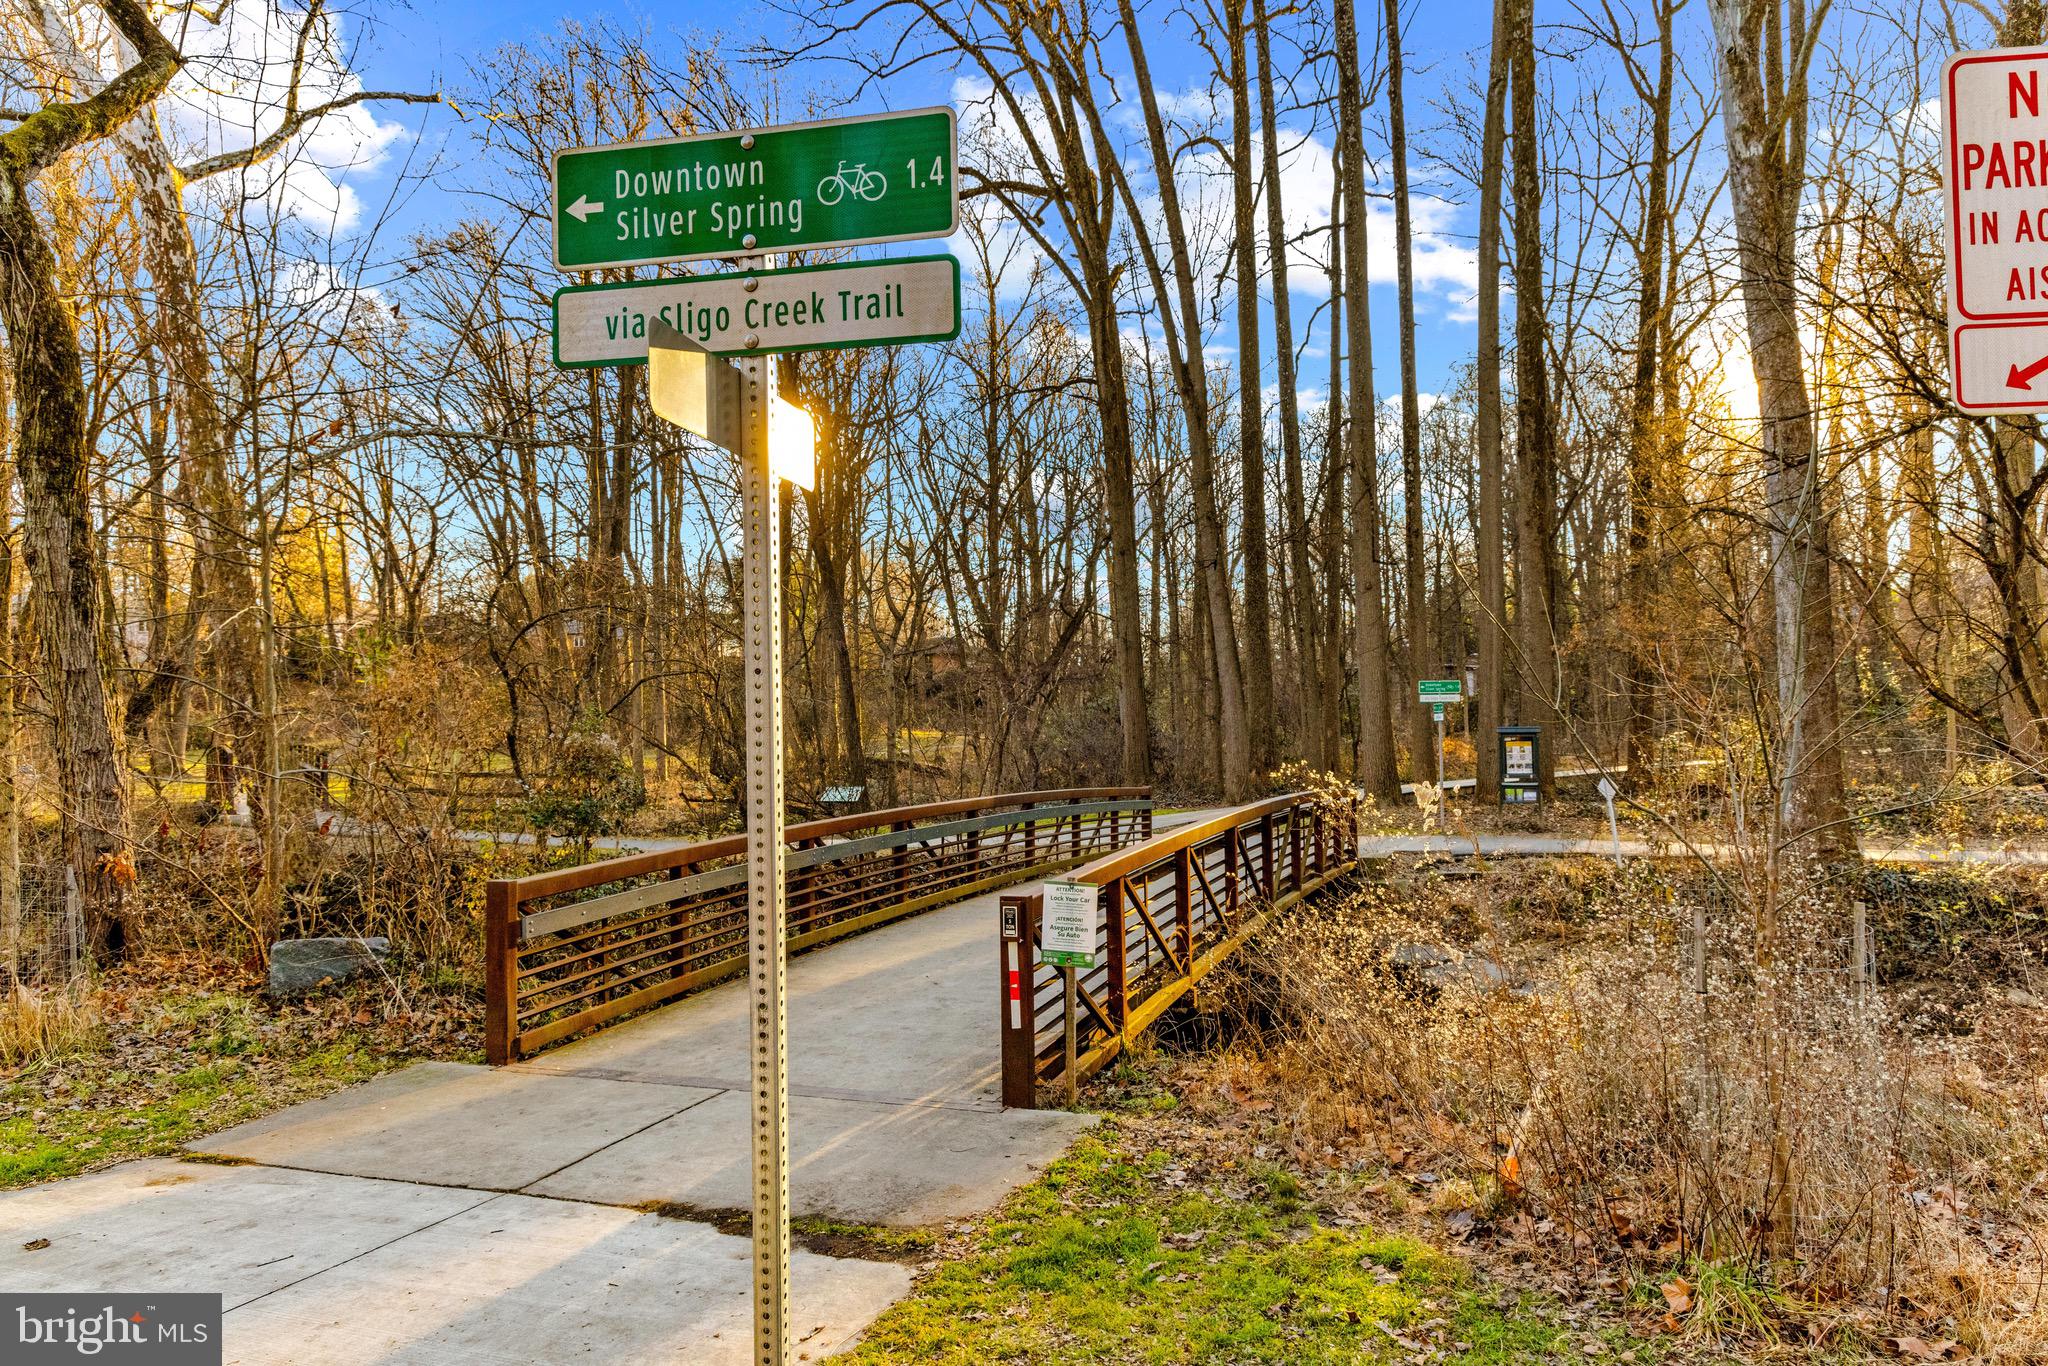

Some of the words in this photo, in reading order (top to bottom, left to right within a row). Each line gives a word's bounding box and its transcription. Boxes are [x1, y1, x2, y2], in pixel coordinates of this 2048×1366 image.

[615, 159, 765, 199] Downtown
[906, 155, 945, 189] 1.4
[616, 207, 697, 241] Silver
[710, 195, 803, 238] Spring
[1969, 211, 1999, 245] IN
[605, 307, 646, 341] via
[659, 301, 730, 342] Sligo
[744, 292, 825, 329] Creek
[837, 283, 904, 321] Trail
[1050, 924, 1074, 933] Asegure
